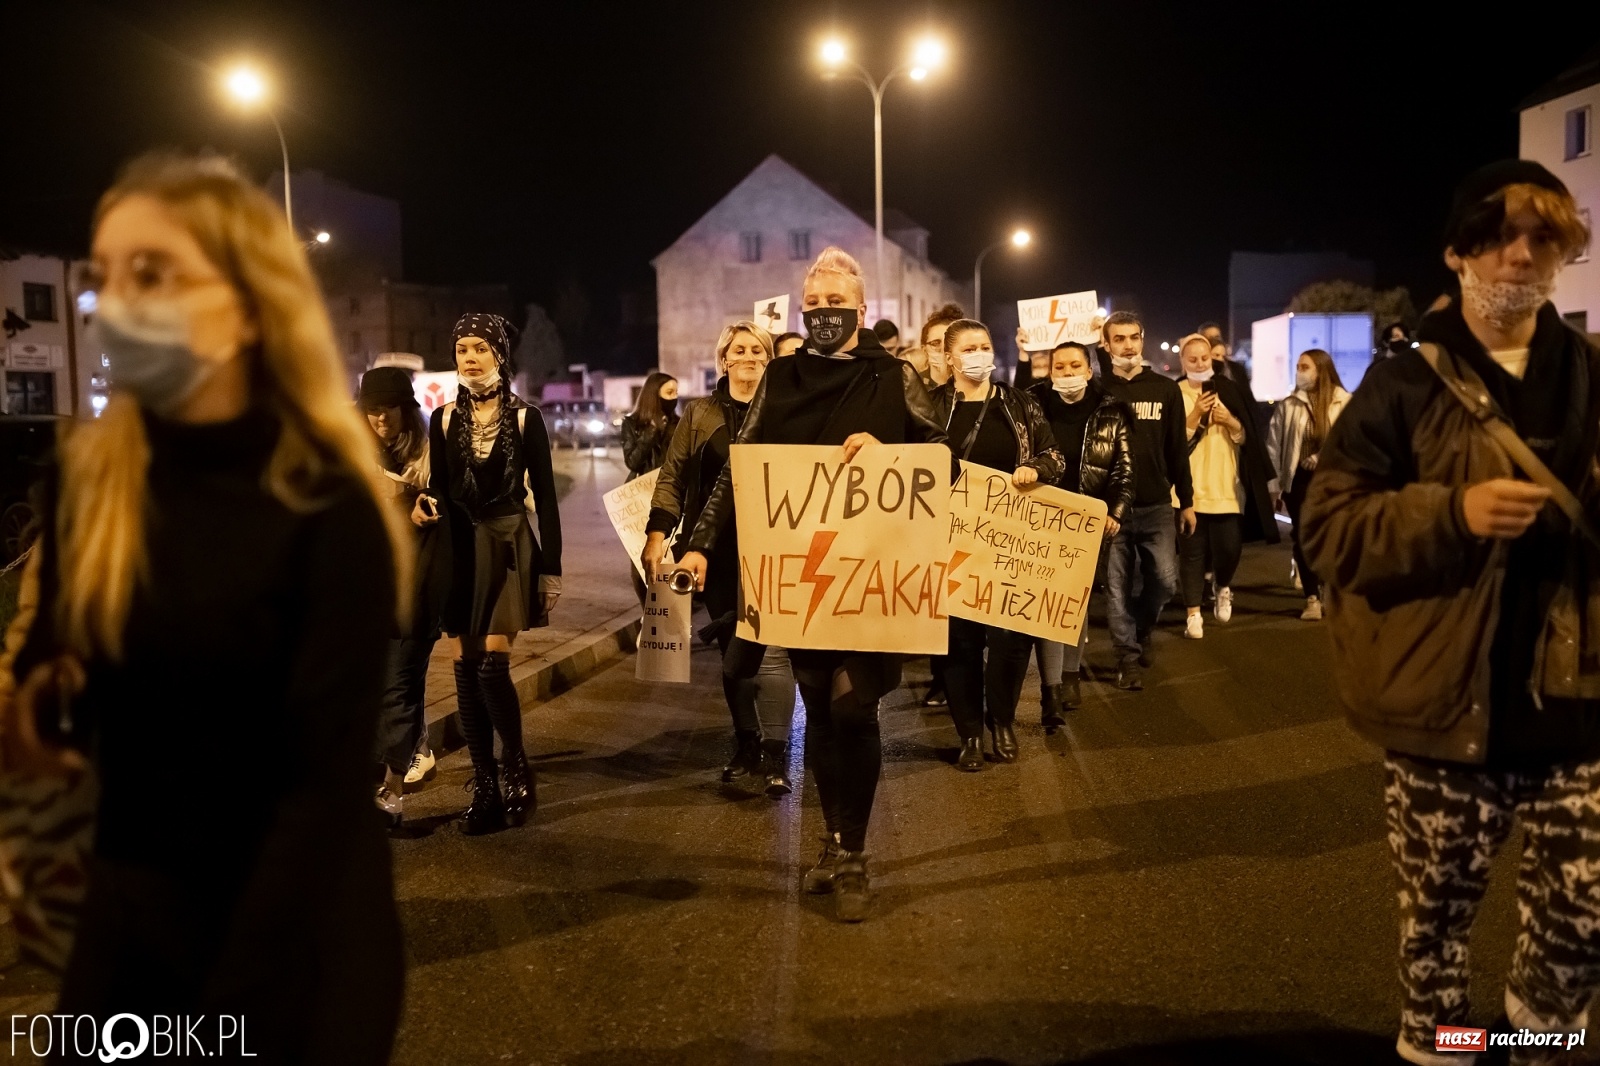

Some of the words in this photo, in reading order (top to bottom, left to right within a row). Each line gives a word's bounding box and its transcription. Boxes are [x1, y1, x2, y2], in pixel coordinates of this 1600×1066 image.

[763, 456, 936, 530] WYBÓR
[950, 468, 970, 508] A
[985, 474, 1101, 533] PAMIĘTACIE
[949, 512, 971, 544] JAK
[973, 516, 1051, 559] KACZYŃSKI
[742, 554, 808, 616] NIE
[832, 557, 948, 620] ZAKAZ
[994, 553, 1034, 580] FAJNY
[962, 574, 993, 615] JA
[1000, 582, 1037, 621] TEŻ
[1037, 586, 1090, 630] NIE!
